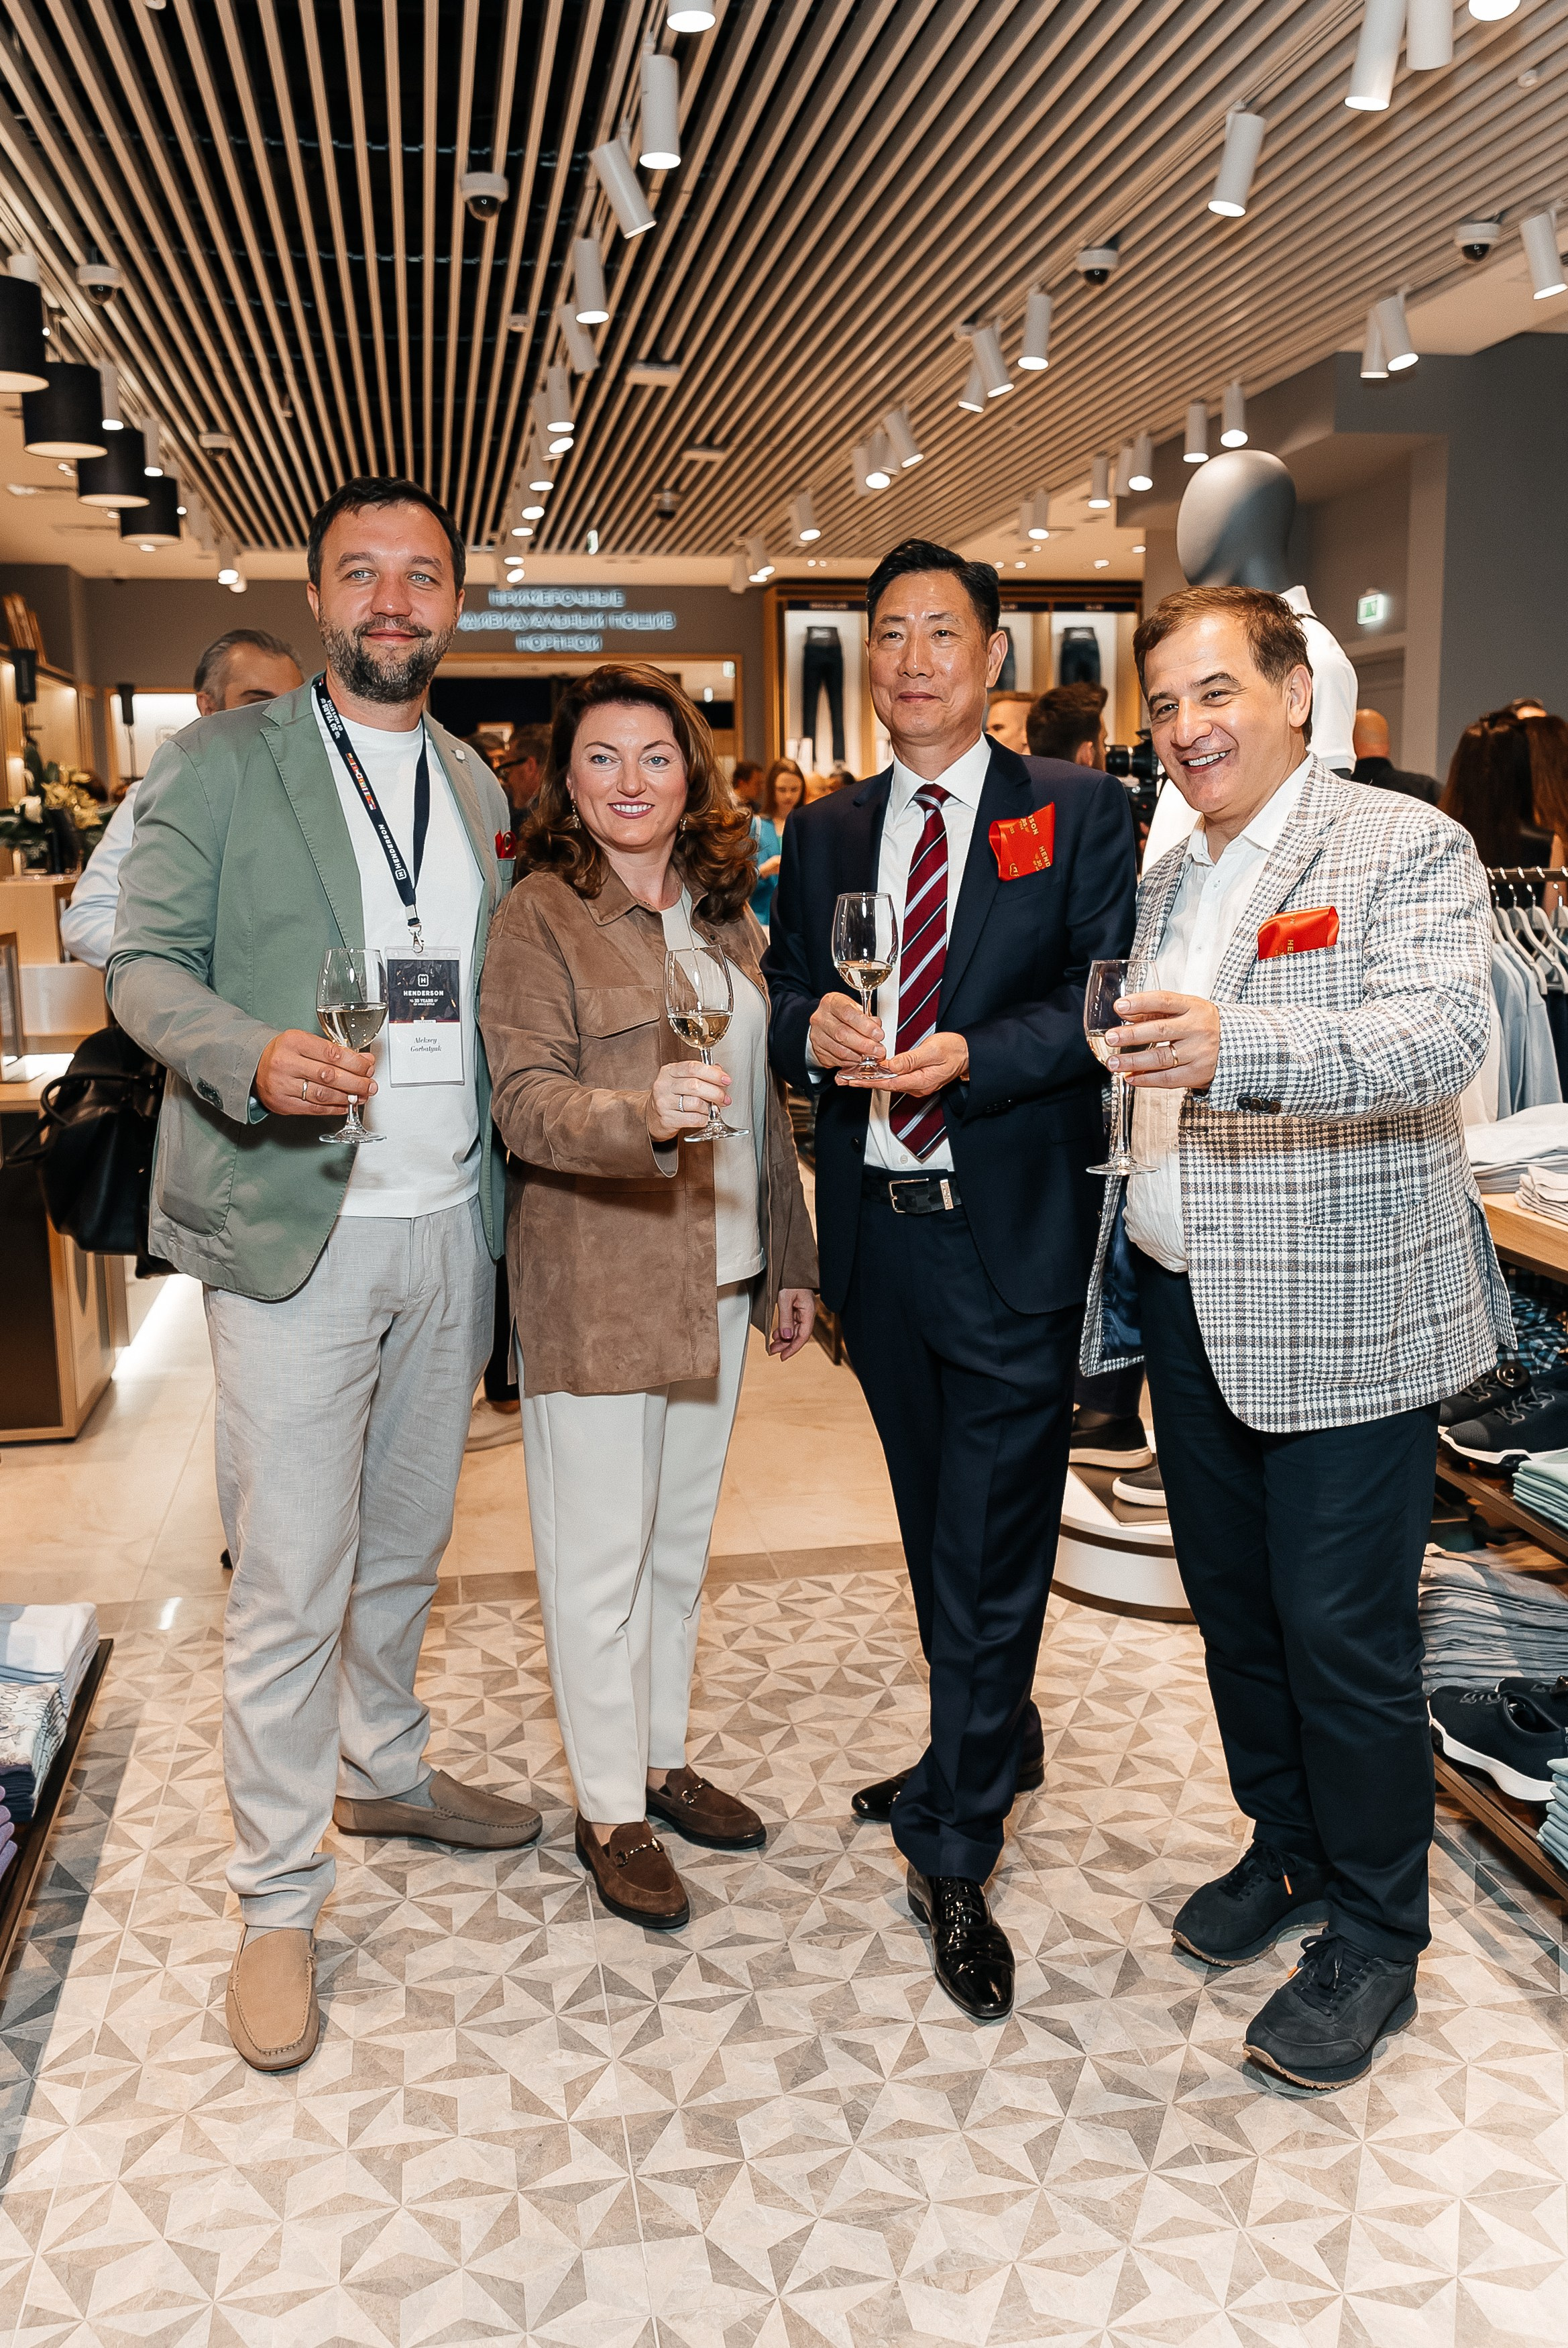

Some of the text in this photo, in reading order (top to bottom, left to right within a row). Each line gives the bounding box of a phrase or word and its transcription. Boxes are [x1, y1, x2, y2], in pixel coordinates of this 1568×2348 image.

[322, 703, 334, 724] YEARS
[378, 824, 402, 869] HENDERSON
[413, 1036, 437, 1045] Aleksey
